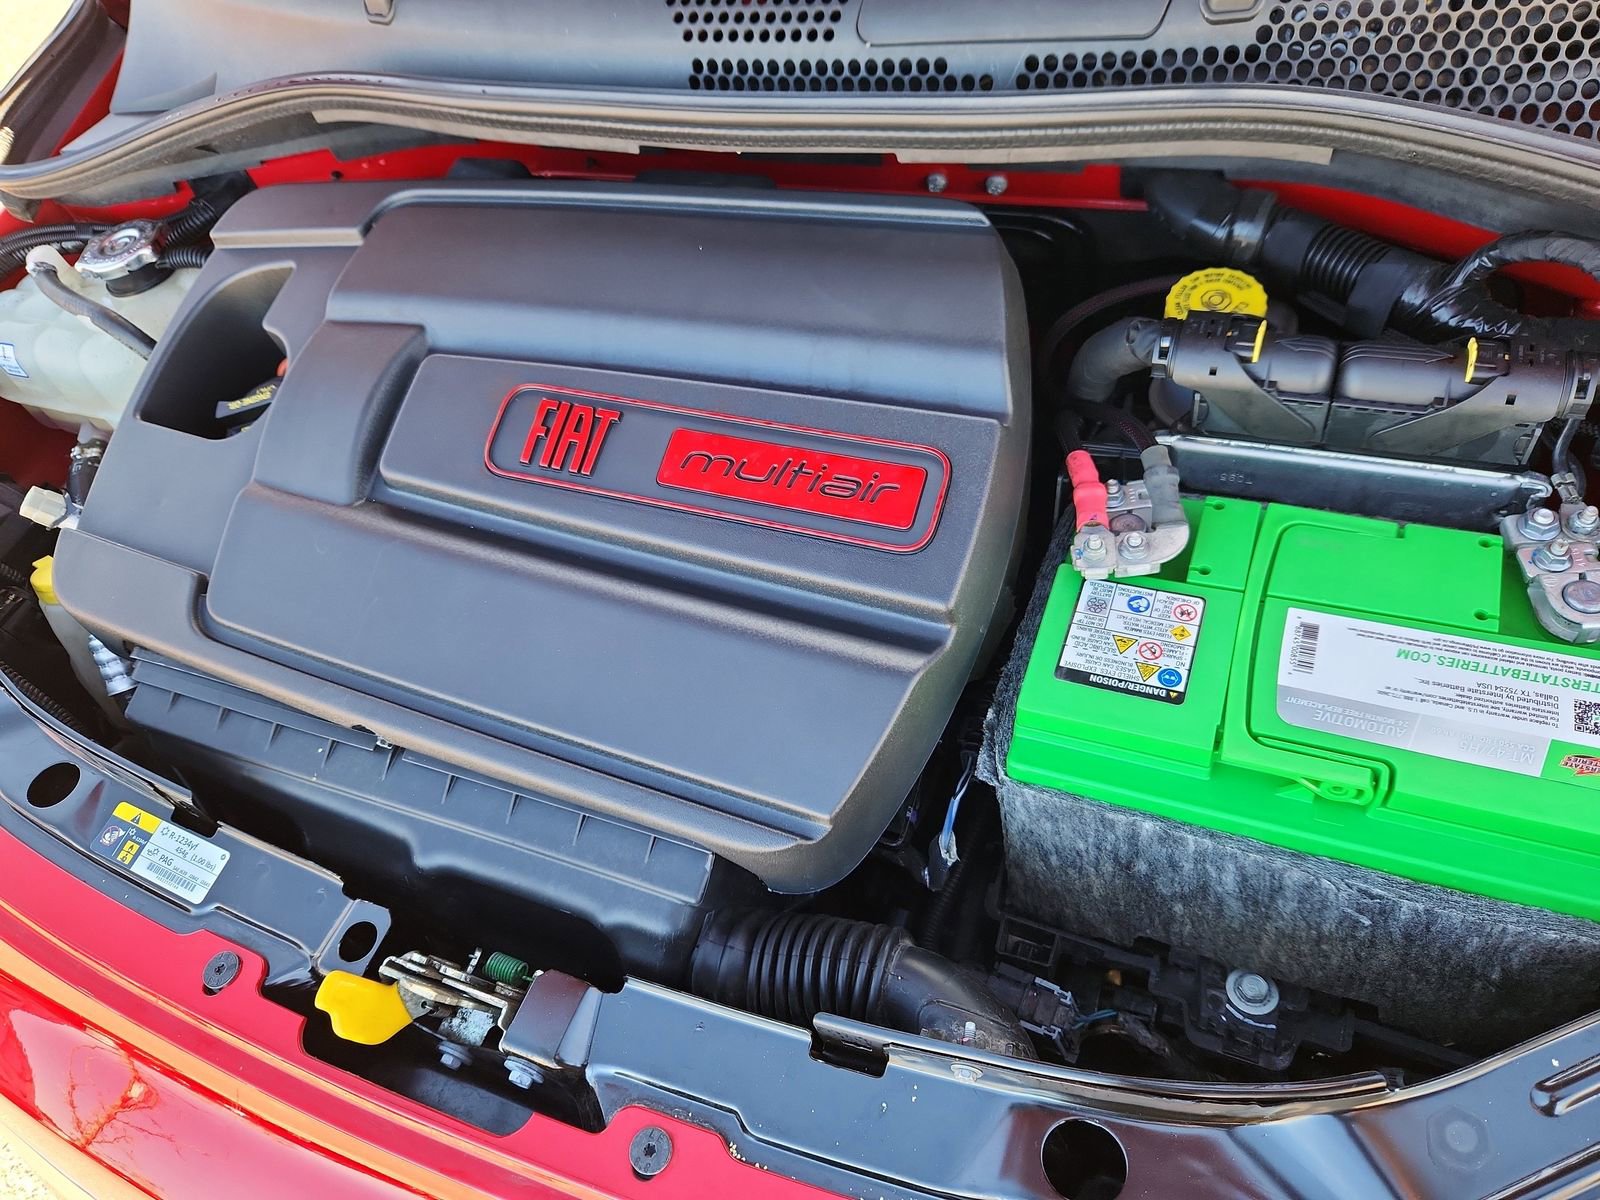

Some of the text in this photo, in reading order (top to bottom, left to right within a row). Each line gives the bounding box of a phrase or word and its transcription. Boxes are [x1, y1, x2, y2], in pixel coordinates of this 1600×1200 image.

[518, 399, 901, 504] FIAT multiair
[1064, 660, 1097, 672] EXPLOSIVE
[1116, 671, 1140, 681] SHIELD
[1088, 673, 1166, 697] DANGER/POISON
[1431, 680, 1465, 692] Batteries
[1475, 681, 1492, 689] USA
[1494, 684, 1517, 694] 75254
[1466, 686, 1503, 699] Interstate
[1531, 691, 1558, 701] Dallas,
[1473, 696, 1503, 705] authorized
[1504, 701, 1530, 710] Batteries
[1516, 695, 1559, 709] Distributed
[1485, 709, 1510, 718] warranty
[1530, 706, 1559, 716] Interstate
[1311, 709, 1407, 738] AUTOMOTIVE
[1528, 718, 1550, 726] replace
[168, 831, 199, 850] R-1234yf
[173, 845, 189, 858] 454g
[158, 853, 174, 866] PAG
